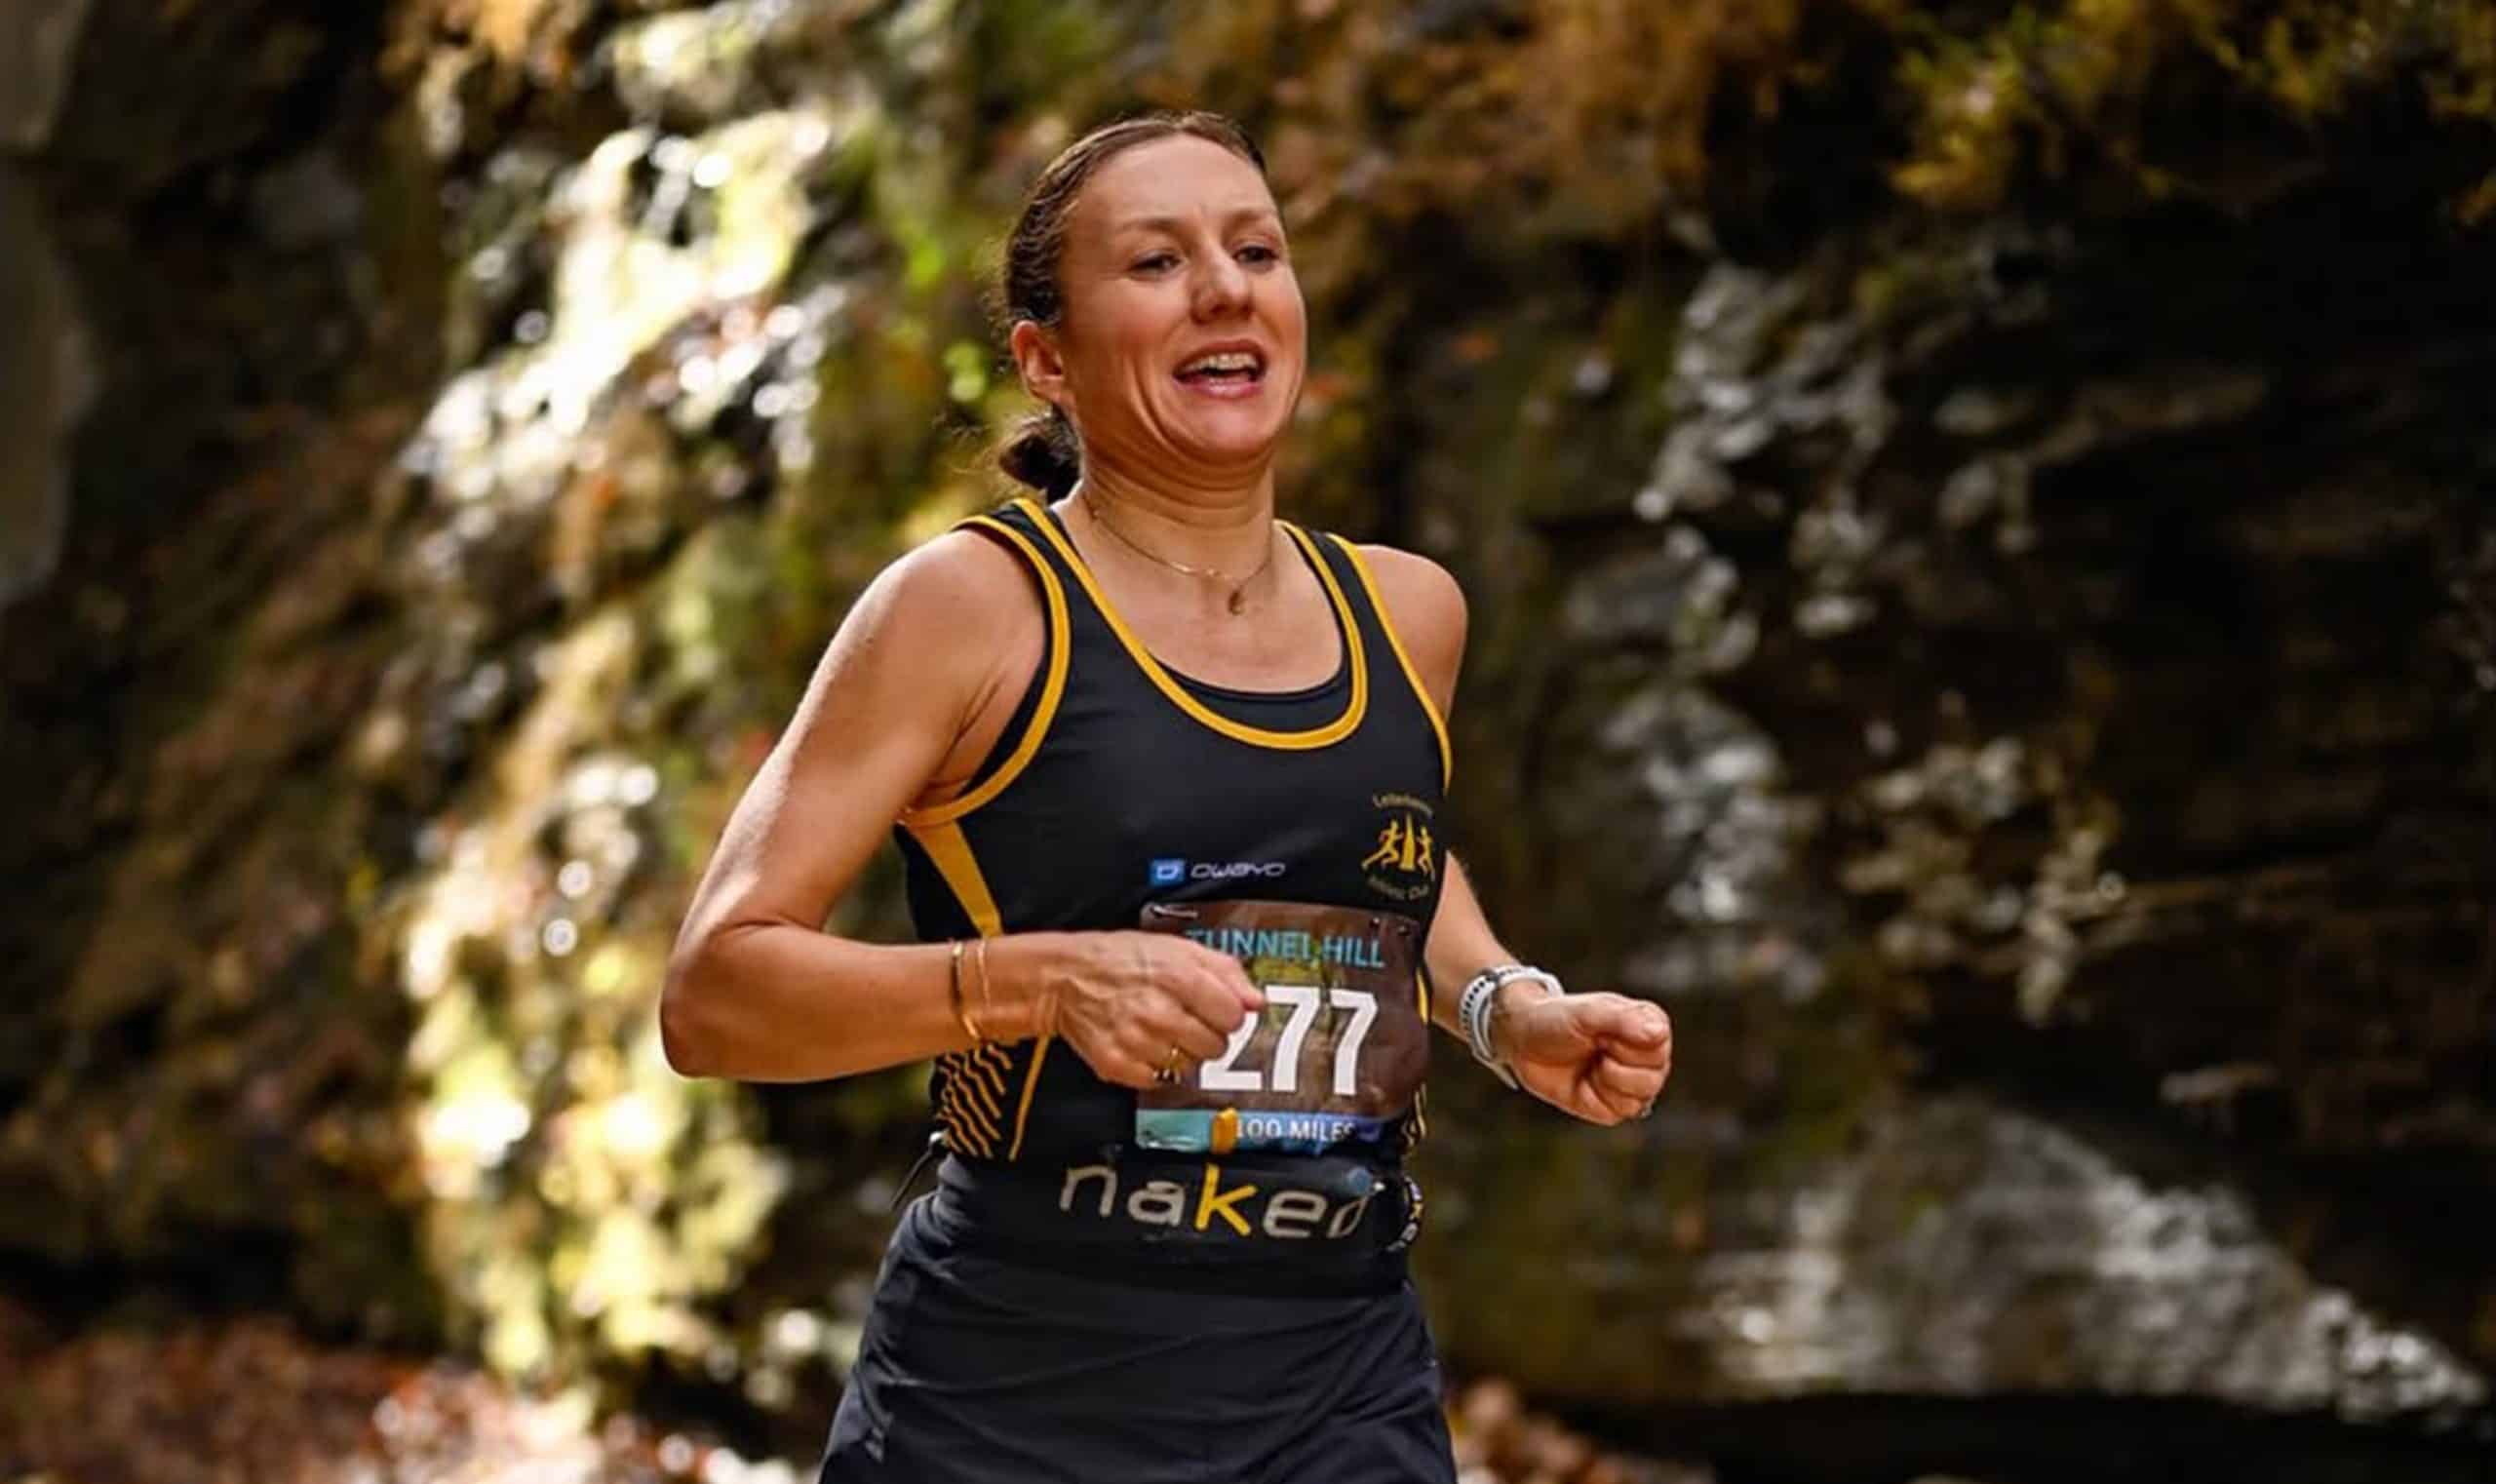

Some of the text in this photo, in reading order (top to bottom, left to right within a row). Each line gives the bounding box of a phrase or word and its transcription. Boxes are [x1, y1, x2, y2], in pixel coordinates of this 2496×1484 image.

[1323, 935, 1385, 968] HILL
[1200, 985, 1379, 1096] 277
[1235, 1118, 1281, 1140] 100
